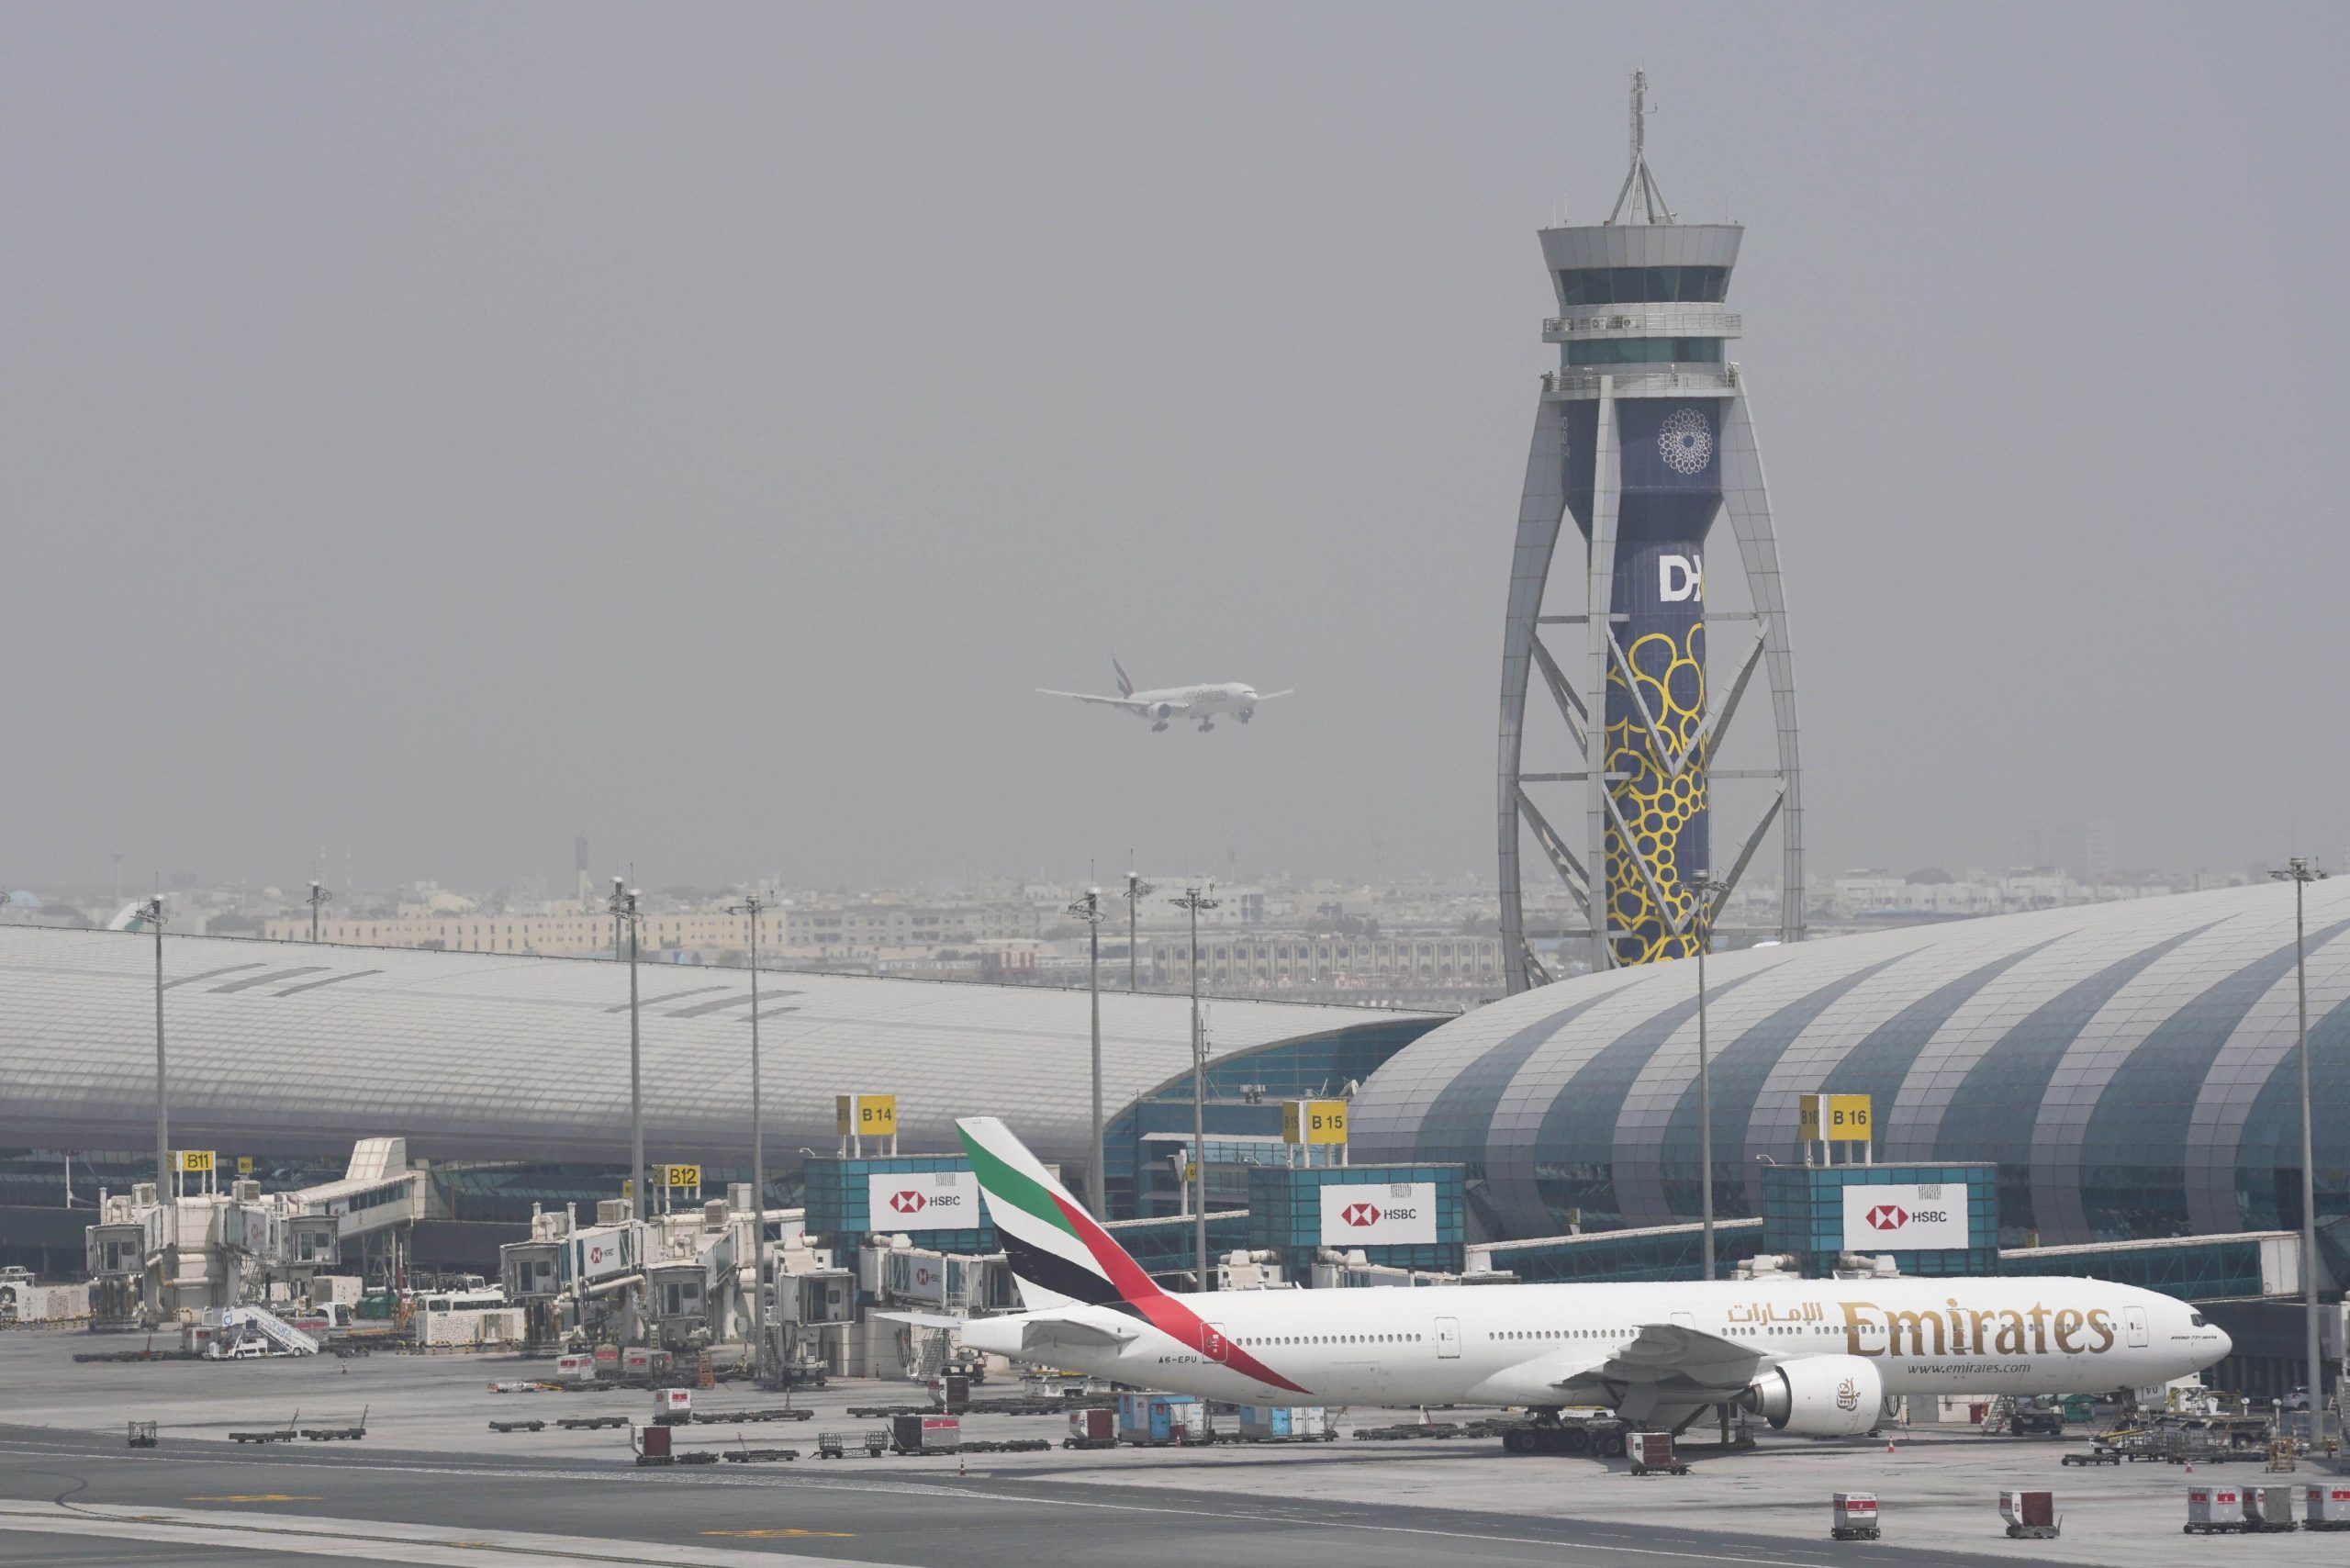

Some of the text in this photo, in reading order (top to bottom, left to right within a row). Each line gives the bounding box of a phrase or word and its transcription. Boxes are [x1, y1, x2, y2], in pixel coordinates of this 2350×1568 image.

[863, 1108, 892, 1122] B 14
[1801, 1111, 1818, 1125] B 16
[1833, 1110, 1866, 1125] B 16
[1312, 1115, 1343, 1130] B 15
[187, 1154, 209, 1168] B11
[669, 1168, 697, 1184] B12
[930, 1196, 960, 1206] HSBC
[1383, 1209, 1416, 1220] HSBC
[1911, 1211, 1947, 1223] HSBC
[1837, 1298, 2115, 1357] Emirates
[1158, 1355, 1197, 1364] A6-EPU
[1908, 1361, 2031, 1374] www.emirates.com
